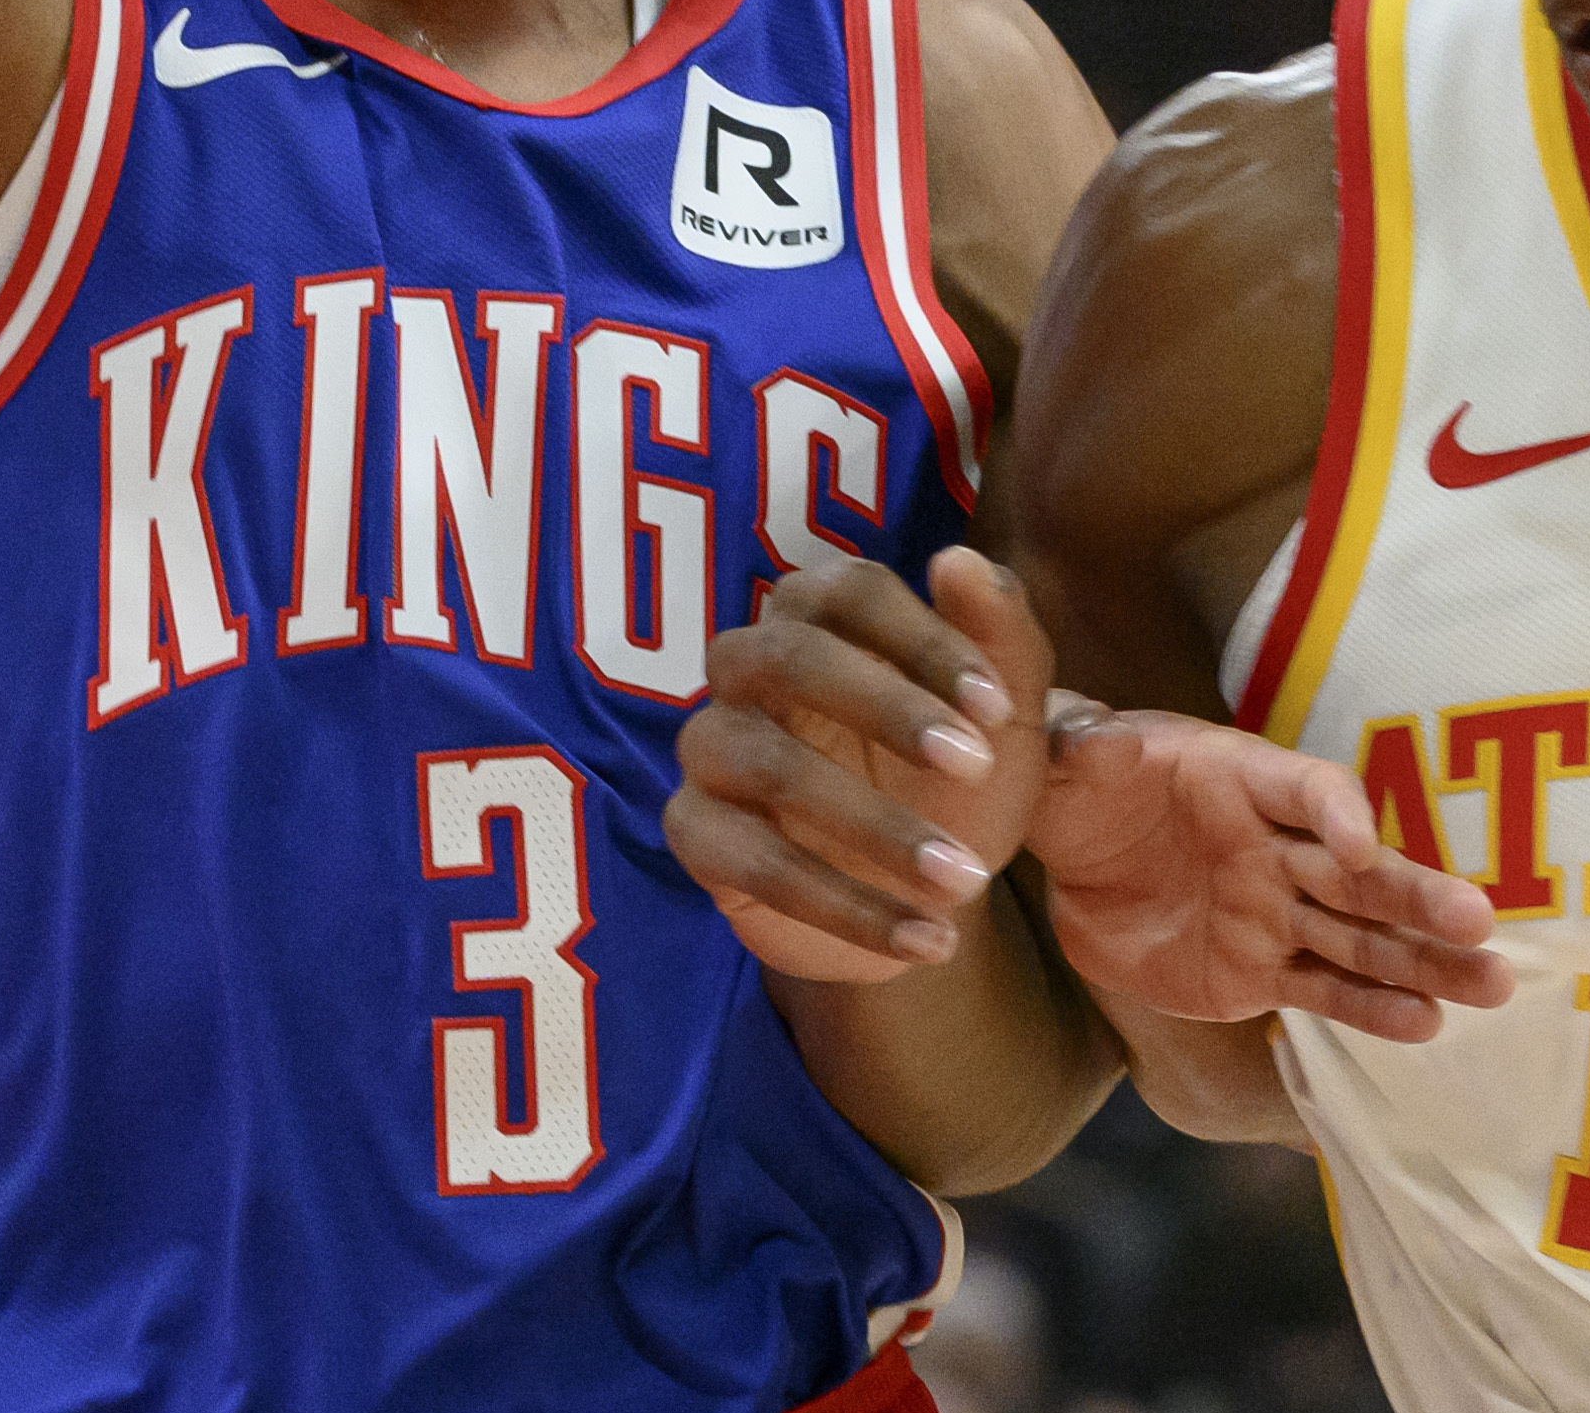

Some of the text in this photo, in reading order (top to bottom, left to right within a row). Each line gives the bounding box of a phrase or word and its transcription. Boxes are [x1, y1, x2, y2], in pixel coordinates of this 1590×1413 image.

[681, 203, 829, 247] REVIVER
[705, 104, 800, 207] R
[88, 266, 888, 729] KINGS
[416, 743, 606, 1197] 3
